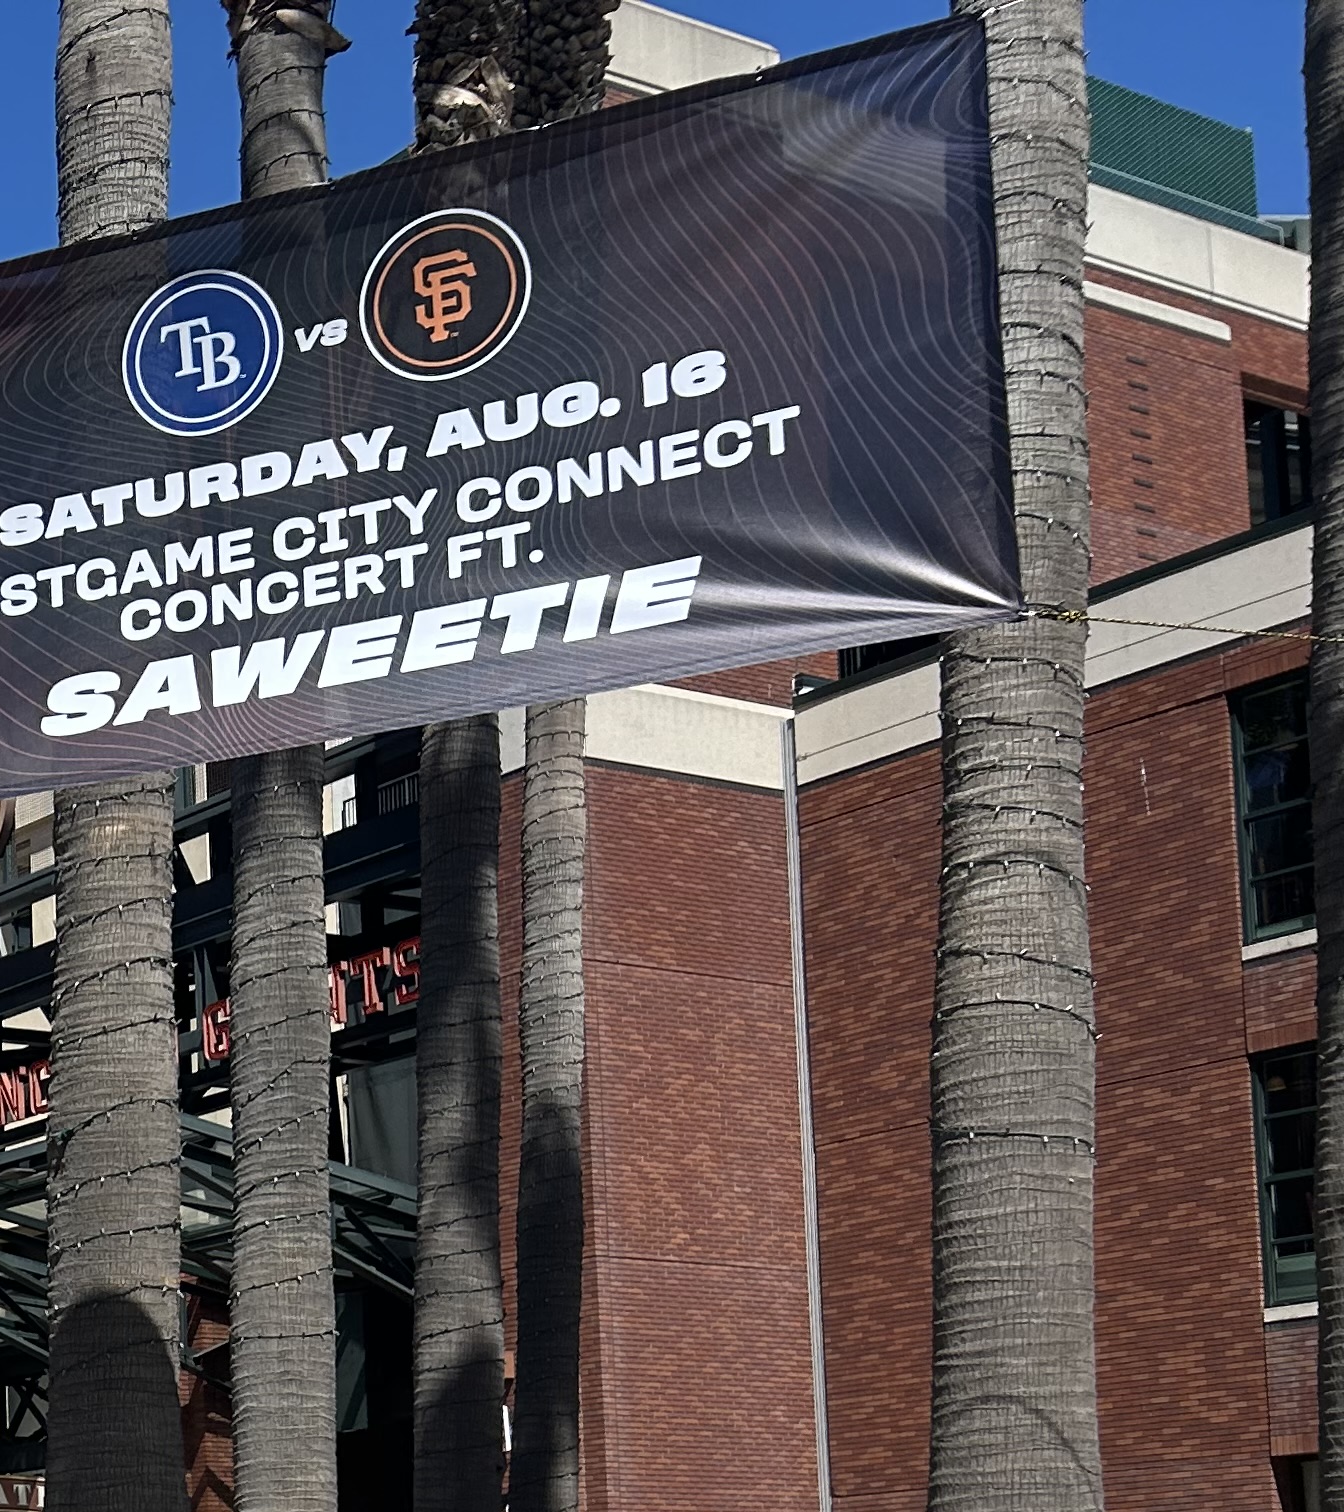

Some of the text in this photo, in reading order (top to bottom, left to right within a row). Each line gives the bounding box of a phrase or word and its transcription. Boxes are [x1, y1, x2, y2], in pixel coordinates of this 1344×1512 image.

[160, 316, 242, 393] TB
[413, 249, 477, 343] SF
[0, 349, 727, 546] SATURDAY, AUG. 16
[271, 488, 438, 562] CITY
[455, 405, 801, 524] CONNECT
[40, 555, 703, 737] SAWEETIE
[120, 521, 544, 641] CONCERT FT.
